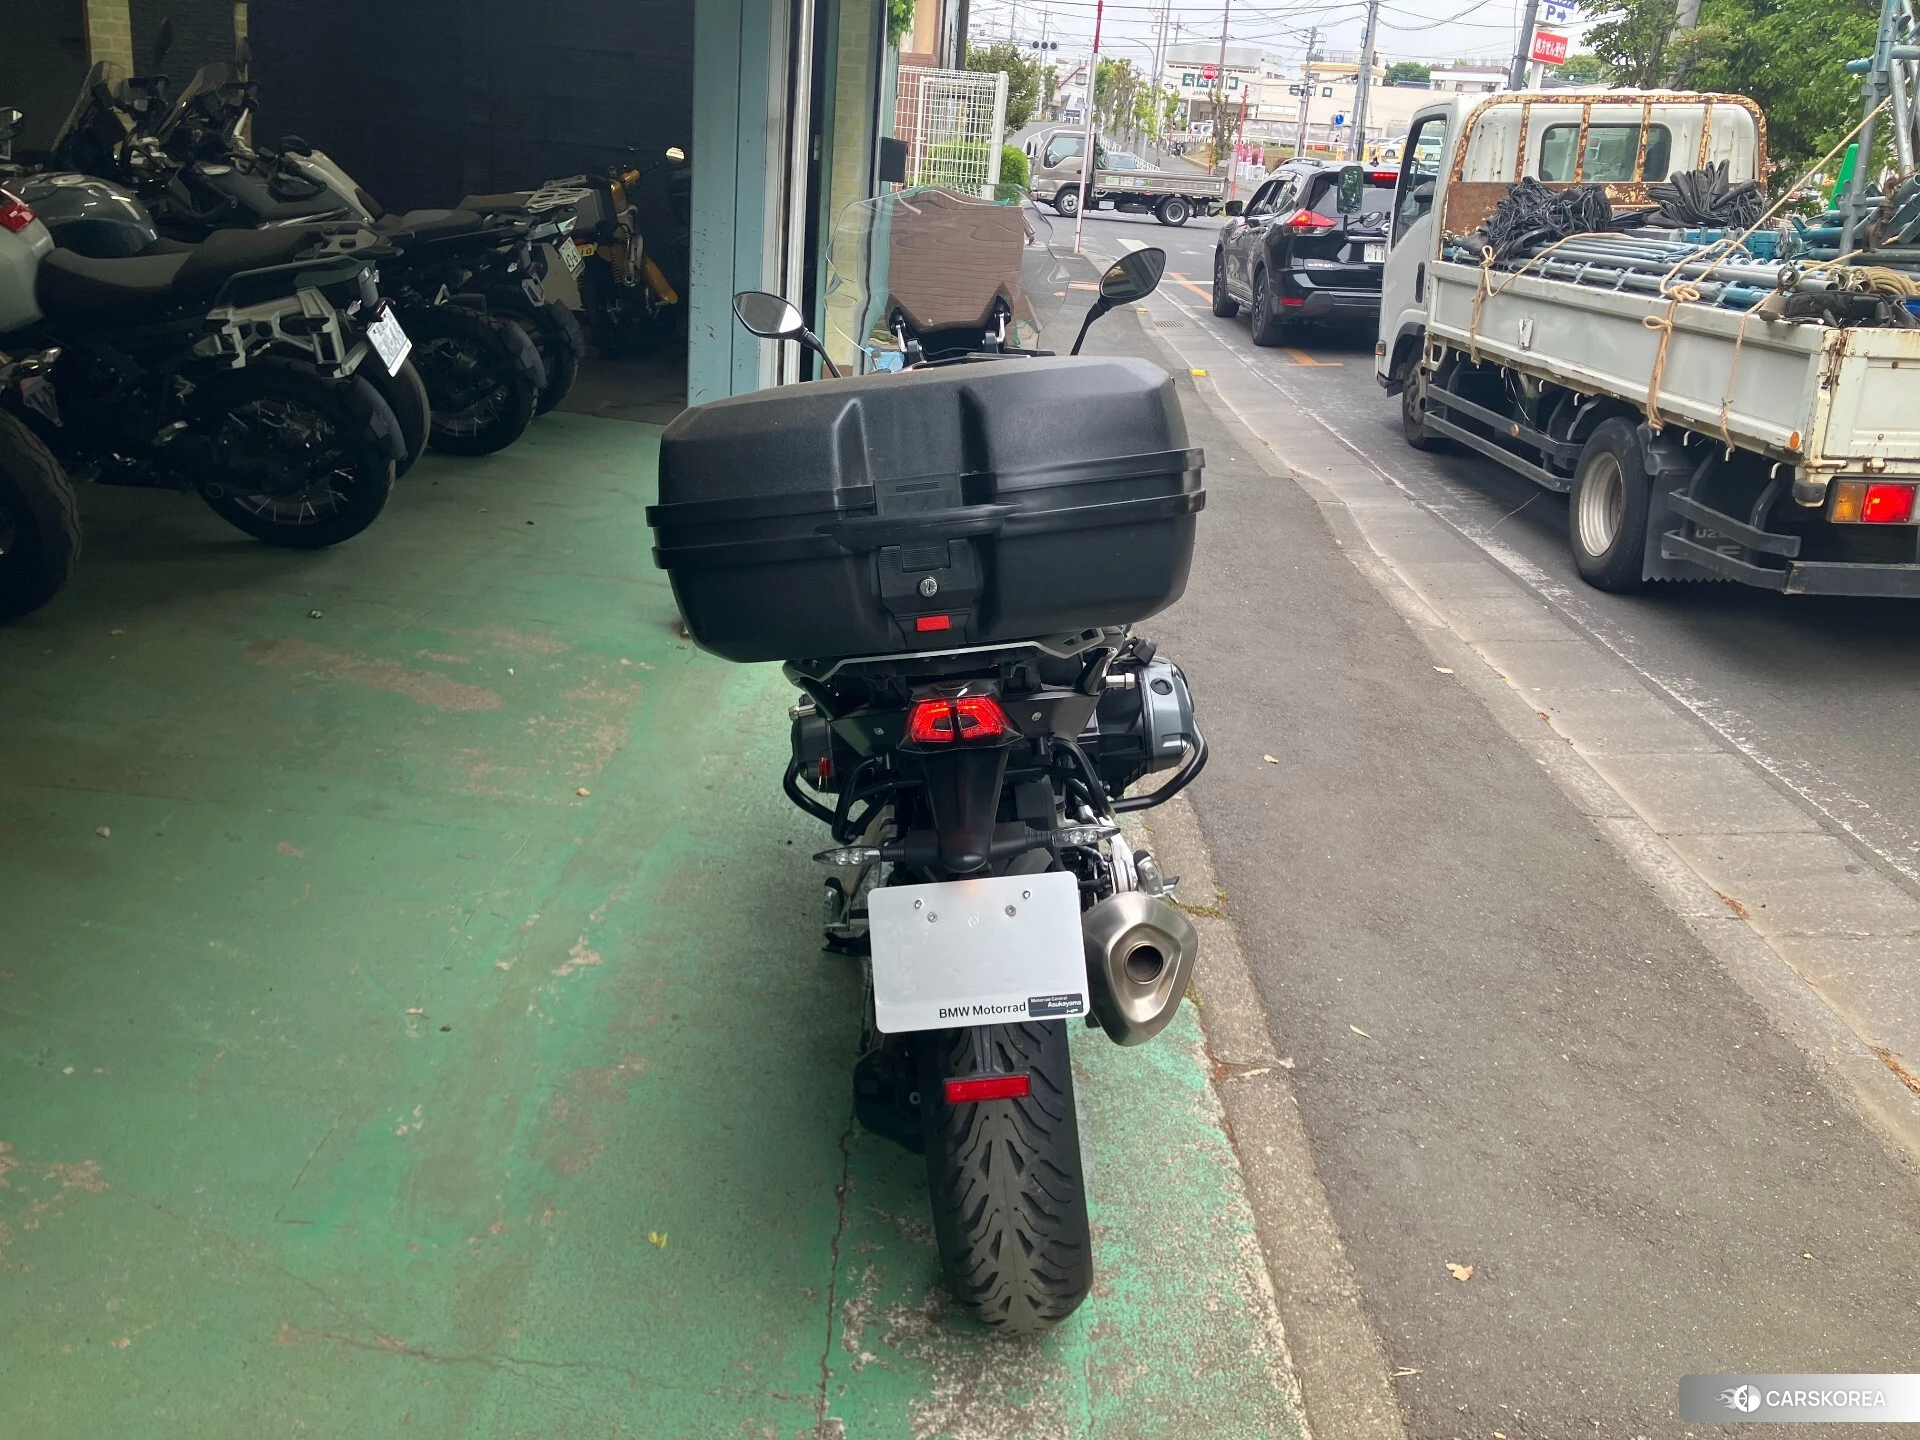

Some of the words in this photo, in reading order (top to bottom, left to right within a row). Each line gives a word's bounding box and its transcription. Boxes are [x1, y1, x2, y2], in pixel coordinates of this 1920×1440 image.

[1545, 4, 1556, 20] P
[939, 1006, 970, 1019] BMW
[972, 1001, 1026, 1016] Motorrad
[1047, 1000, 1081, 1008] Asukayama
